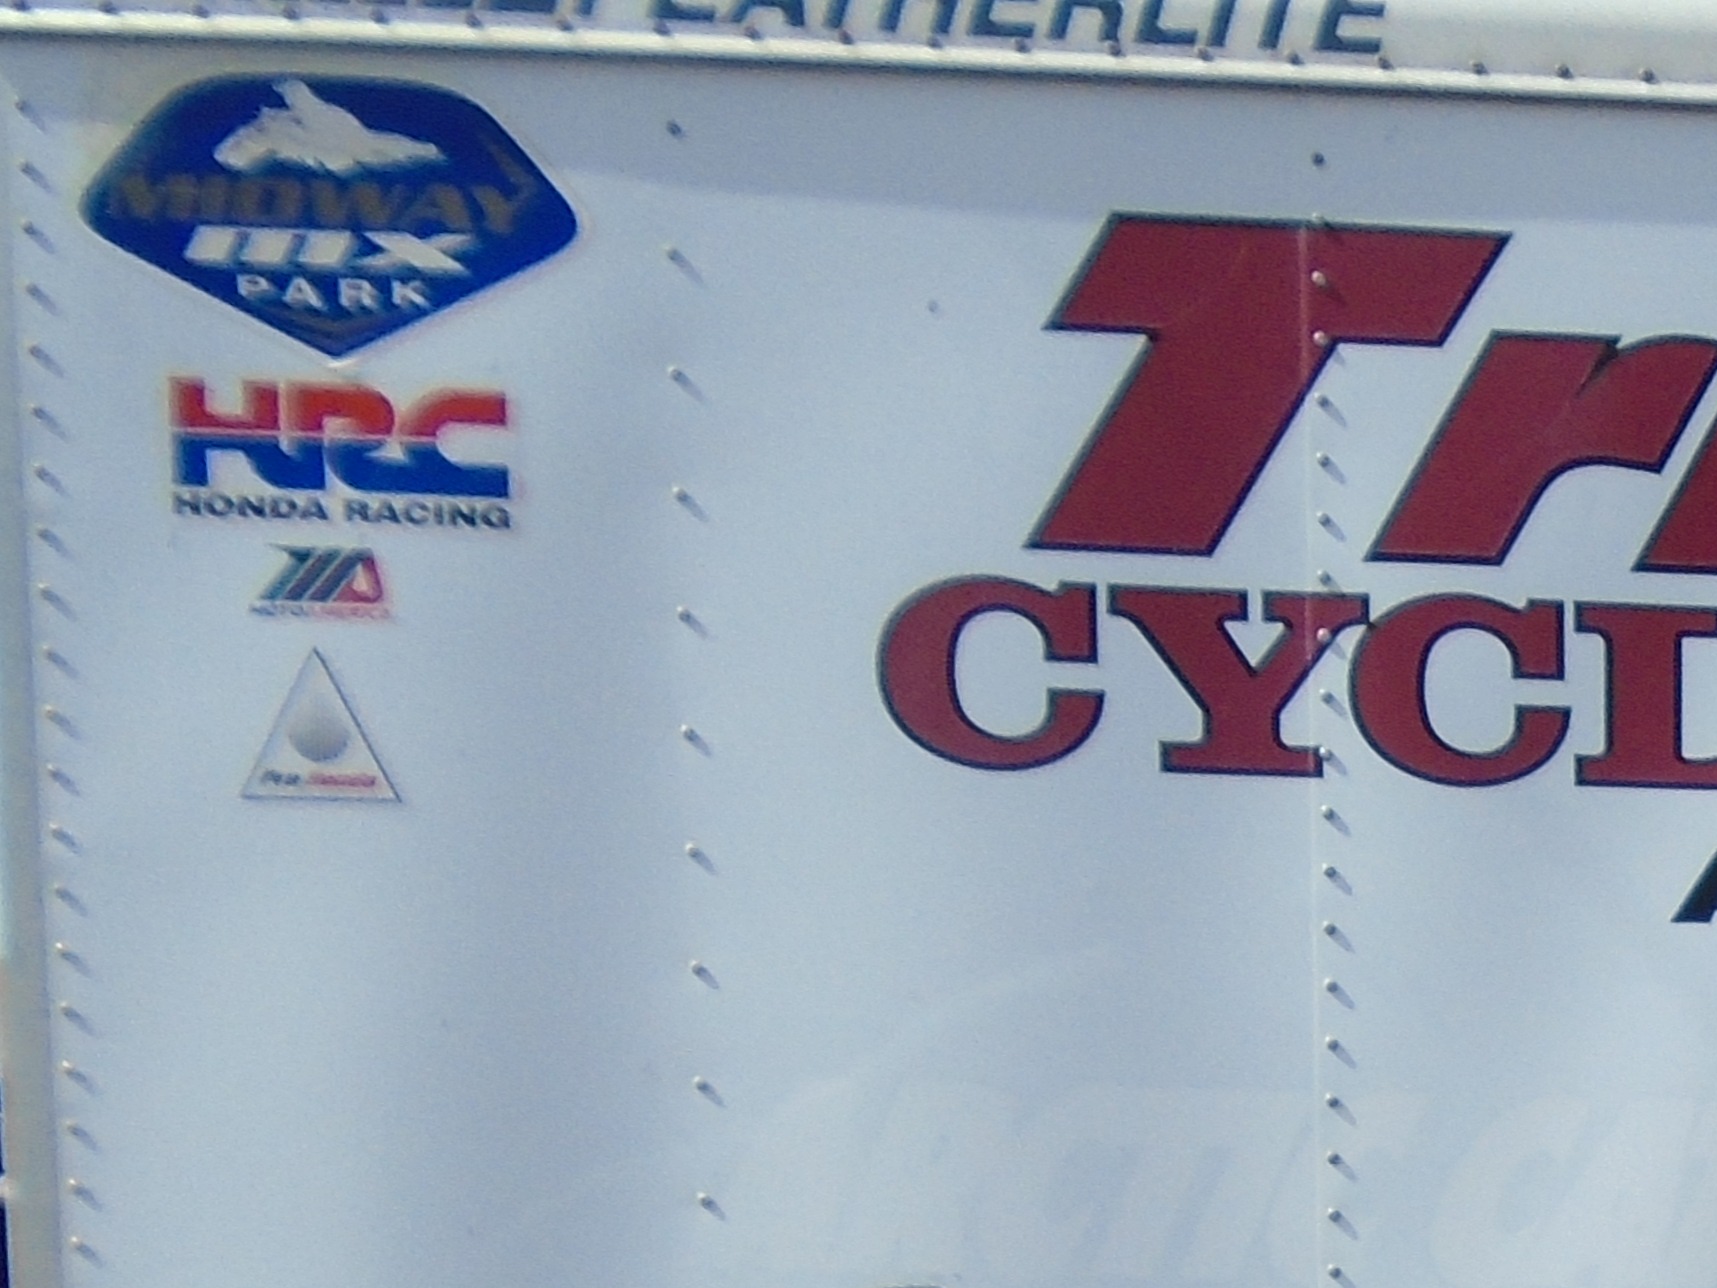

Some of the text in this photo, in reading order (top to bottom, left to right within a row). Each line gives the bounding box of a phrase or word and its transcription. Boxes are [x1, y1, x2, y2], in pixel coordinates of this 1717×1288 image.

[236, 274, 431, 311] PARK
[169, 376, 510, 498] HRC
[172, 492, 512, 530] HONDA RACING
